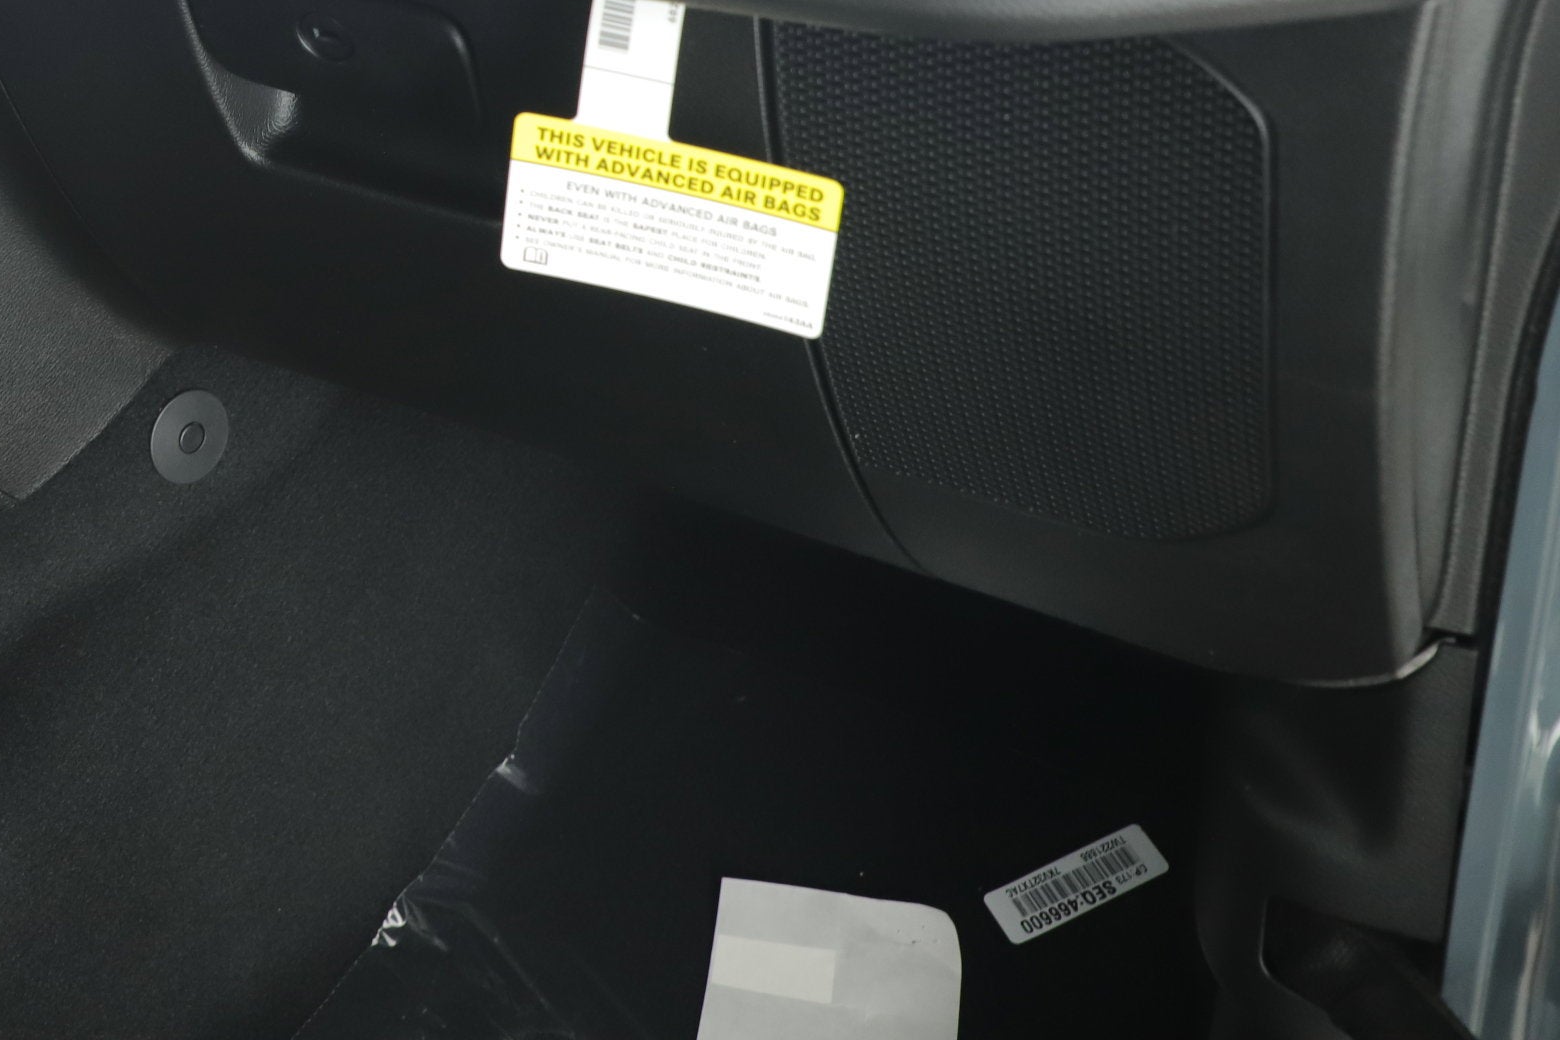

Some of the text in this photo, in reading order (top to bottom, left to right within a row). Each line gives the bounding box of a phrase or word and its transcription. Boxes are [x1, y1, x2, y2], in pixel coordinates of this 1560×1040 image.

[535, 145, 821, 222] WITH ADVANCED AIR BAGS
[537, 126, 824, 203] THIS VEHICLE IS EQUIPPED
[567, 180, 777, 237] EVEN WITH ADVANCED AIR BAGS
[1020, 880, 1117, 934] SEQ:466600
